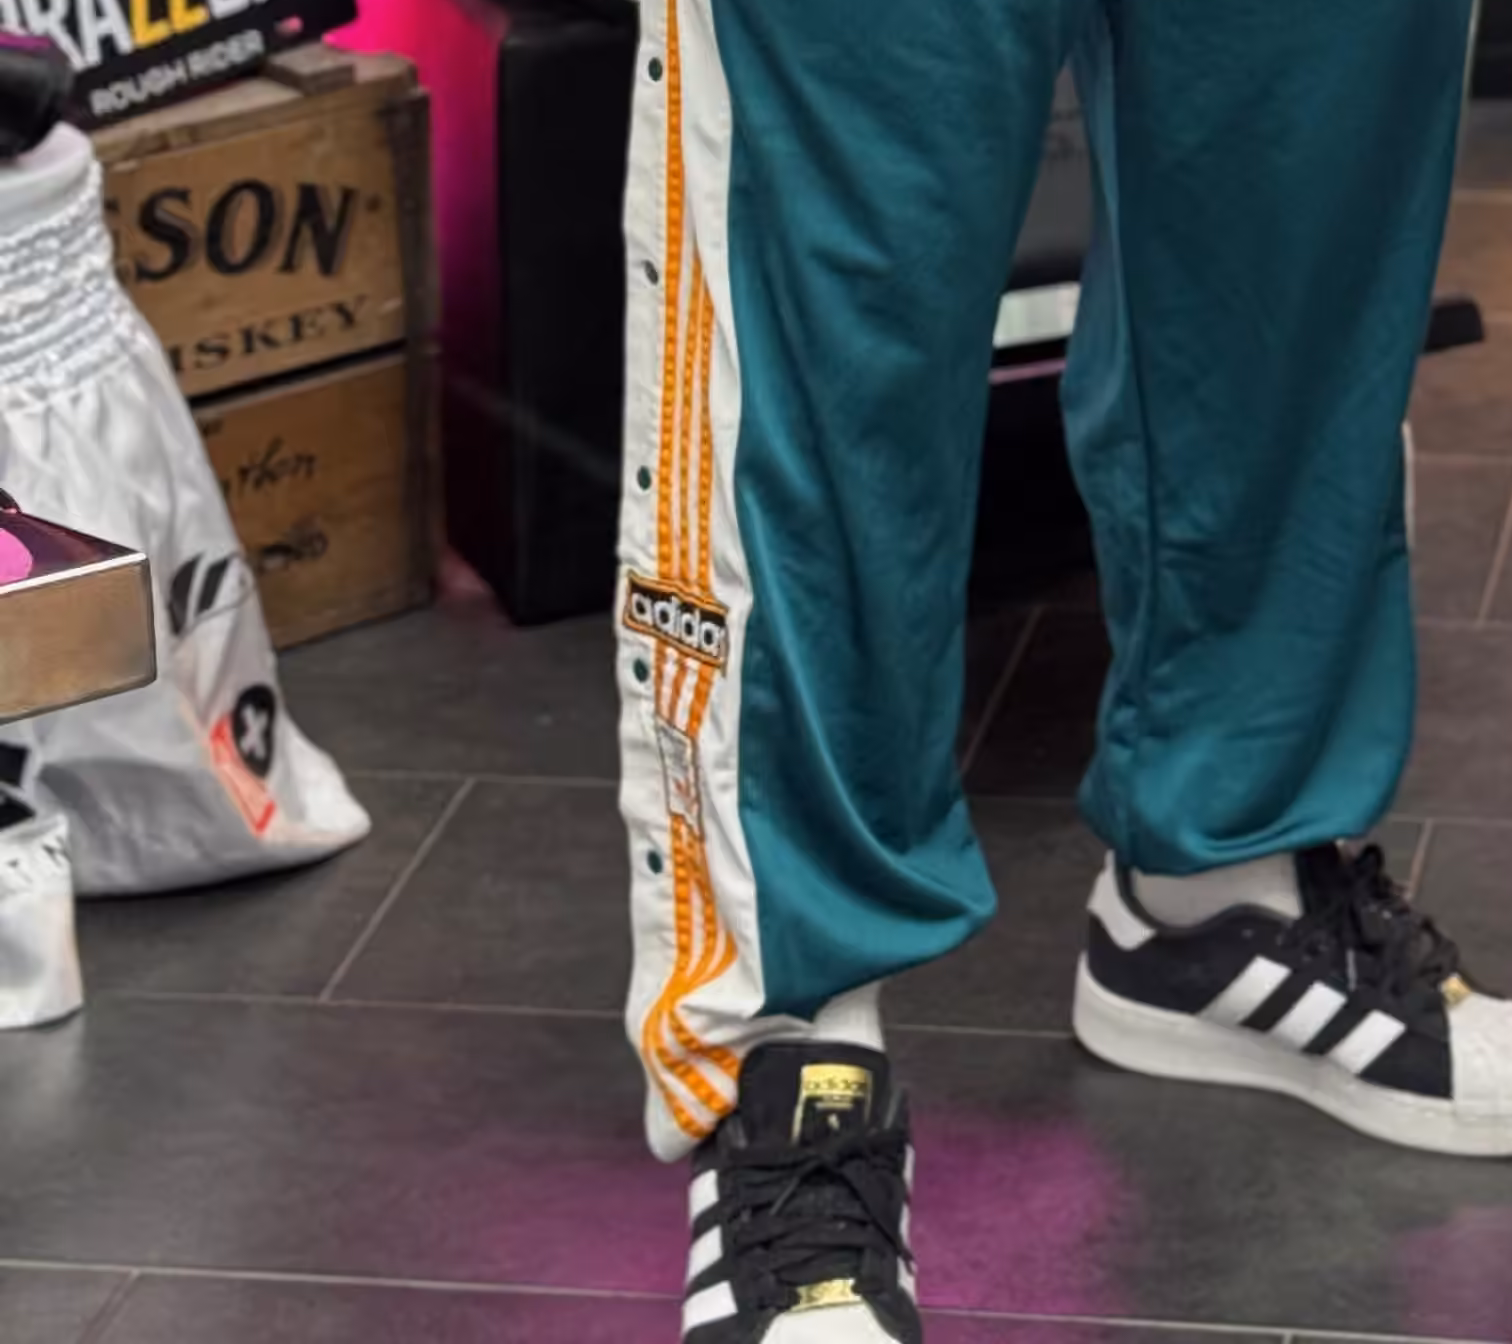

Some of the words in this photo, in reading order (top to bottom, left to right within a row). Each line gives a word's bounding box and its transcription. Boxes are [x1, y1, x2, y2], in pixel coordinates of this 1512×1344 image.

[90, 59, 187, 116] ROUGH
[187, 30, 264, 79] RIDER
[104, 178, 357, 282] SON
[168, 294, 367, 372] ISKEY
[632, 593, 724, 657] adida
